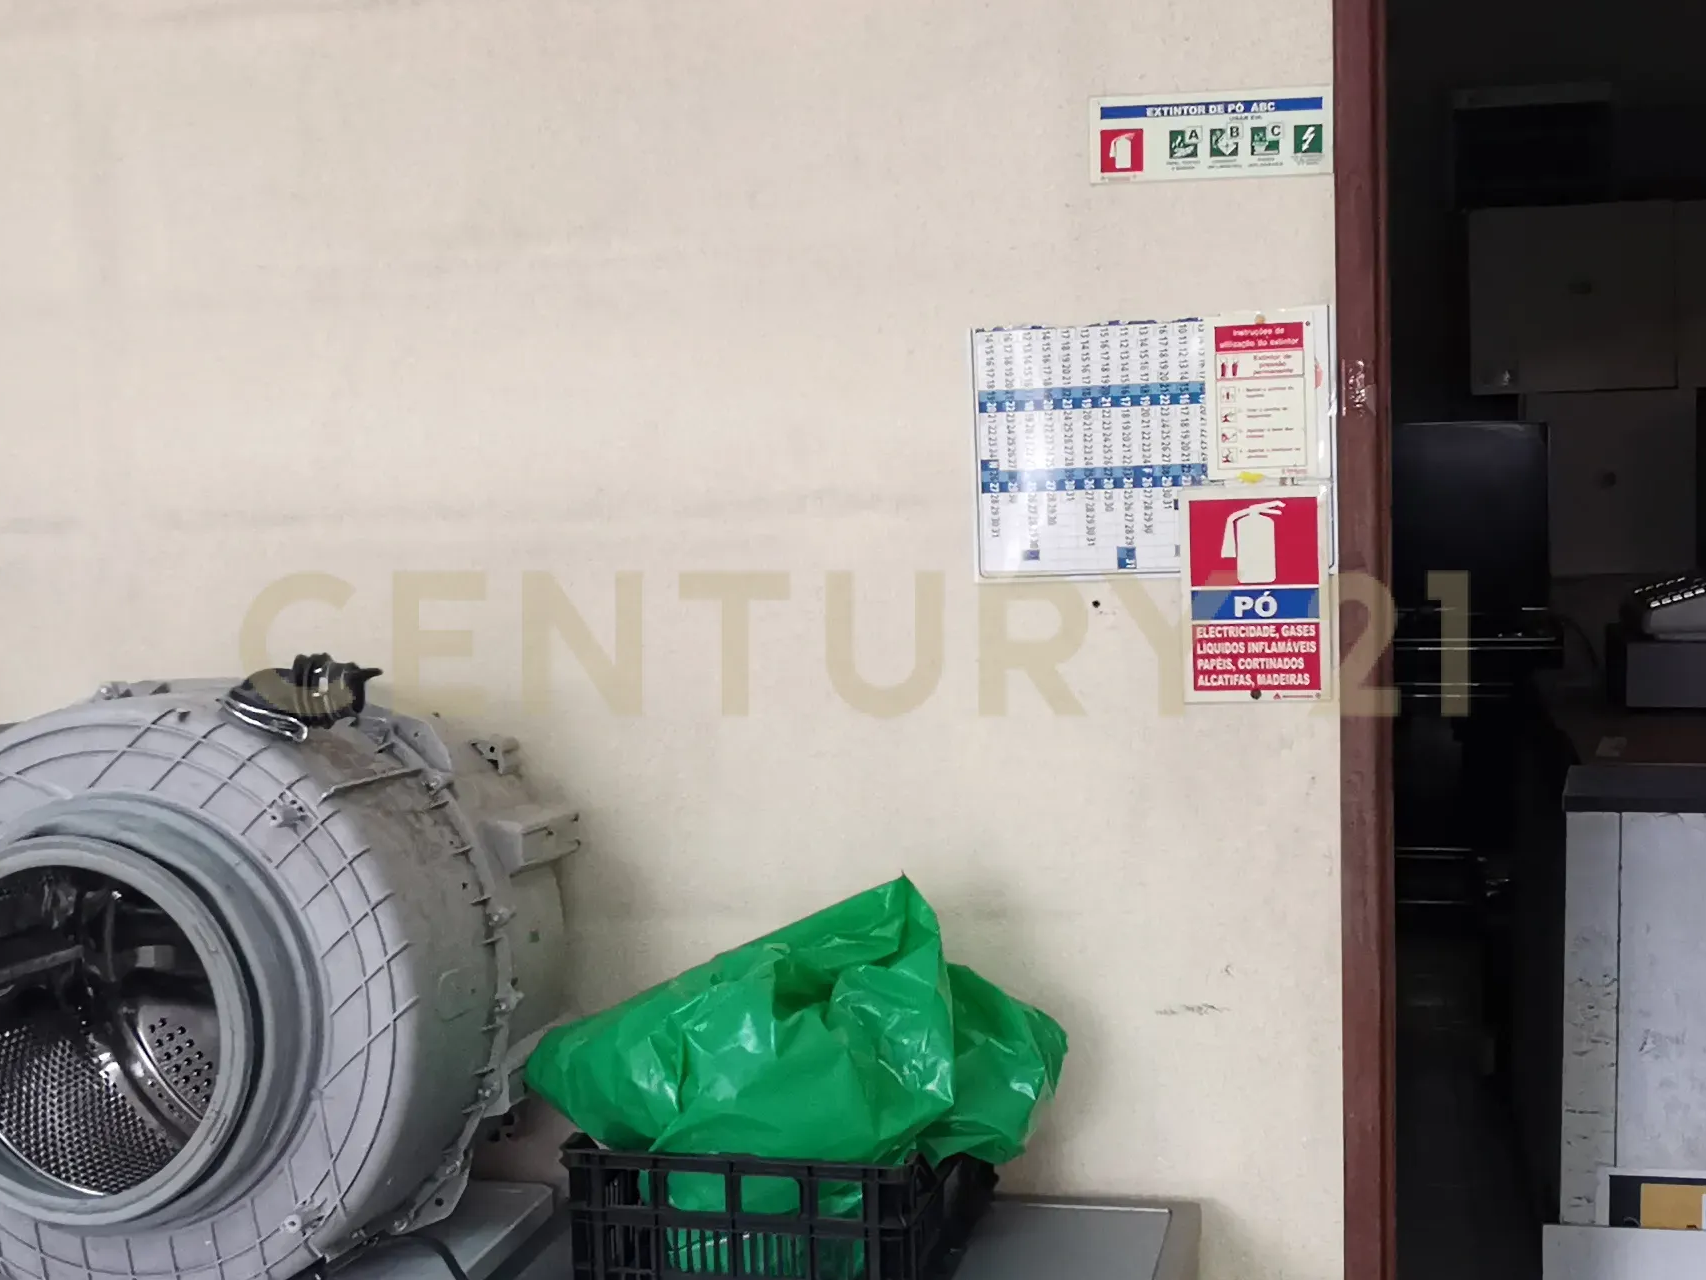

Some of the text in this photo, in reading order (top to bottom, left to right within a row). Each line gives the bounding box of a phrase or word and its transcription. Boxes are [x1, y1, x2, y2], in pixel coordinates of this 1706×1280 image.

[1146, 101, 1275, 117] EXTINTOR DE PÓ ABC
[1188, 129, 1199, 140] A
[1230, 126, 1240, 138] B
[1271, 125, 1281, 136] C
[1062, 330, 1070, 338] 17
[1100, 328, 1109, 337] 15
[1120, 327, 1128, 336] 11
[1139, 327, 1148, 335] 13
[1159, 325, 1167, 334] 16
[1178, 325, 1187, 334] 10
[1100, 340, 1109, 349] 16
[1120, 339, 1129, 348] 12
[1140, 338, 1148, 347] 14
[1159, 337, 1168, 346] 17
[1179, 336, 1187, 344] 11
[1061, 342, 1070, 351] 18
[1101, 352, 1110, 360] 17
[1120, 351, 1129, 360] 13
[1140, 350, 1149, 359] 15
[1159, 349, 1168, 358] 18
[1179, 348, 1188, 356] 12
[1062, 354, 1070, 362] 19
[1101, 363, 1110, 372] 18
[1121, 363, 1129, 371] 14
[1140, 362, 1149, 370] 16
[1160, 361, 1168, 369] 19
[1179, 360, 1188, 368] 13
[1062, 365, 1071, 374] 20
[1062, 376, 1071, 385] 21
[1101, 375, 1110, 383] 19
[1121, 374, 1130, 383] 15
[1141, 373, 1149, 382] 17
[1160, 372, 1169, 381] 20
[1180, 372, 1190, 380] 14
[1160, 384, 1169, 392] 21
[1179, 383, 1189, 392] 15
[1101, 397, 1111, 406] 21
[1121, 397, 1130, 406] 17
[1140, 397, 1150, 405] 19
[1160, 395, 1169, 404] 22
[1100, 409, 1111, 418] 22
[1121, 409, 1130, 418] 18
[1141, 409, 1150, 417] 20
[1160, 407, 1170, 416] 23
[1181, 406, 1189, 415] 17
[1064, 411, 1072, 420] 24
[1102, 421, 1111, 430] 23
[1122, 421, 1131, 430] 19
[1141, 420, 1150, 428] 21
[1161, 419, 1169, 428] 24
[1181, 418, 1189, 427] 18
[1064, 423, 1073, 432] 25
[1064, 434, 1073, 444] 26
[1080, 329, 1096, 546] 13 14 15 16 17 19 20 21 22 23 24 26 27 28 29 30 31
[1103, 433, 1112, 442] 24
[1122, 432, 1131, 441] 20
[1142, 431, 1150, 440] 22
[1161, 430, 1170, 440] 25
[1181, 430, 1190, 439] 19
[1064, 446, 1074, 455] 27
[1103, 445, 1112, 454] 25
[1122, 444, 1131, 452] 21
[1142, 443, 1151, 452] 23
[1161, 442, 1171, 451] 26
[1181, 442, 1190, 451] 20
[1065, 457, 1074, 466] 28
[1104, 456, 1113, 465] 26
[1122, 455, 1132, 464] 22
[1143, 454, 1151, 463] 24
[1162, 454, 1171, 462] 27
[1181, 453, 1190, 462] 21
[1066, 492, 1075, 501] 31
[1104, 491, 1113, 500] 29
[1124, 490, 1133, 498] 25
[1143, 489, 1153, 498] 27
[1162, 489, 1172, 498] 30
[1105, 503, 1114, 512] 30
[1124, 502, 1133, 511] 26
[1144, 501, 1153, 510] 28
[1163, 500, 1172, 509] 31
[1125, 513, 1134, 522] 27
[1144, 512, 1153, 522] 29
[1125, 525, 1134, 534] 28
[1144, 524, 1153, 533] 30
[1125, 536, 1134, 545] 29
[1126, 559, 1135, 568] 31
[1234, 591, 1278, 618] PÓ
[1196, 624, 1315, 639] ELECTRICIDADE, GASES
[1196, 639, 1317, 655] LÍQUIDOS INFLAMÁVEIS
[1196, 656, 1304, 672] PAPÉIS, CORTINADOS
[1197, 673, 1310, 688] ALCATIFAS, MADEIRAS
